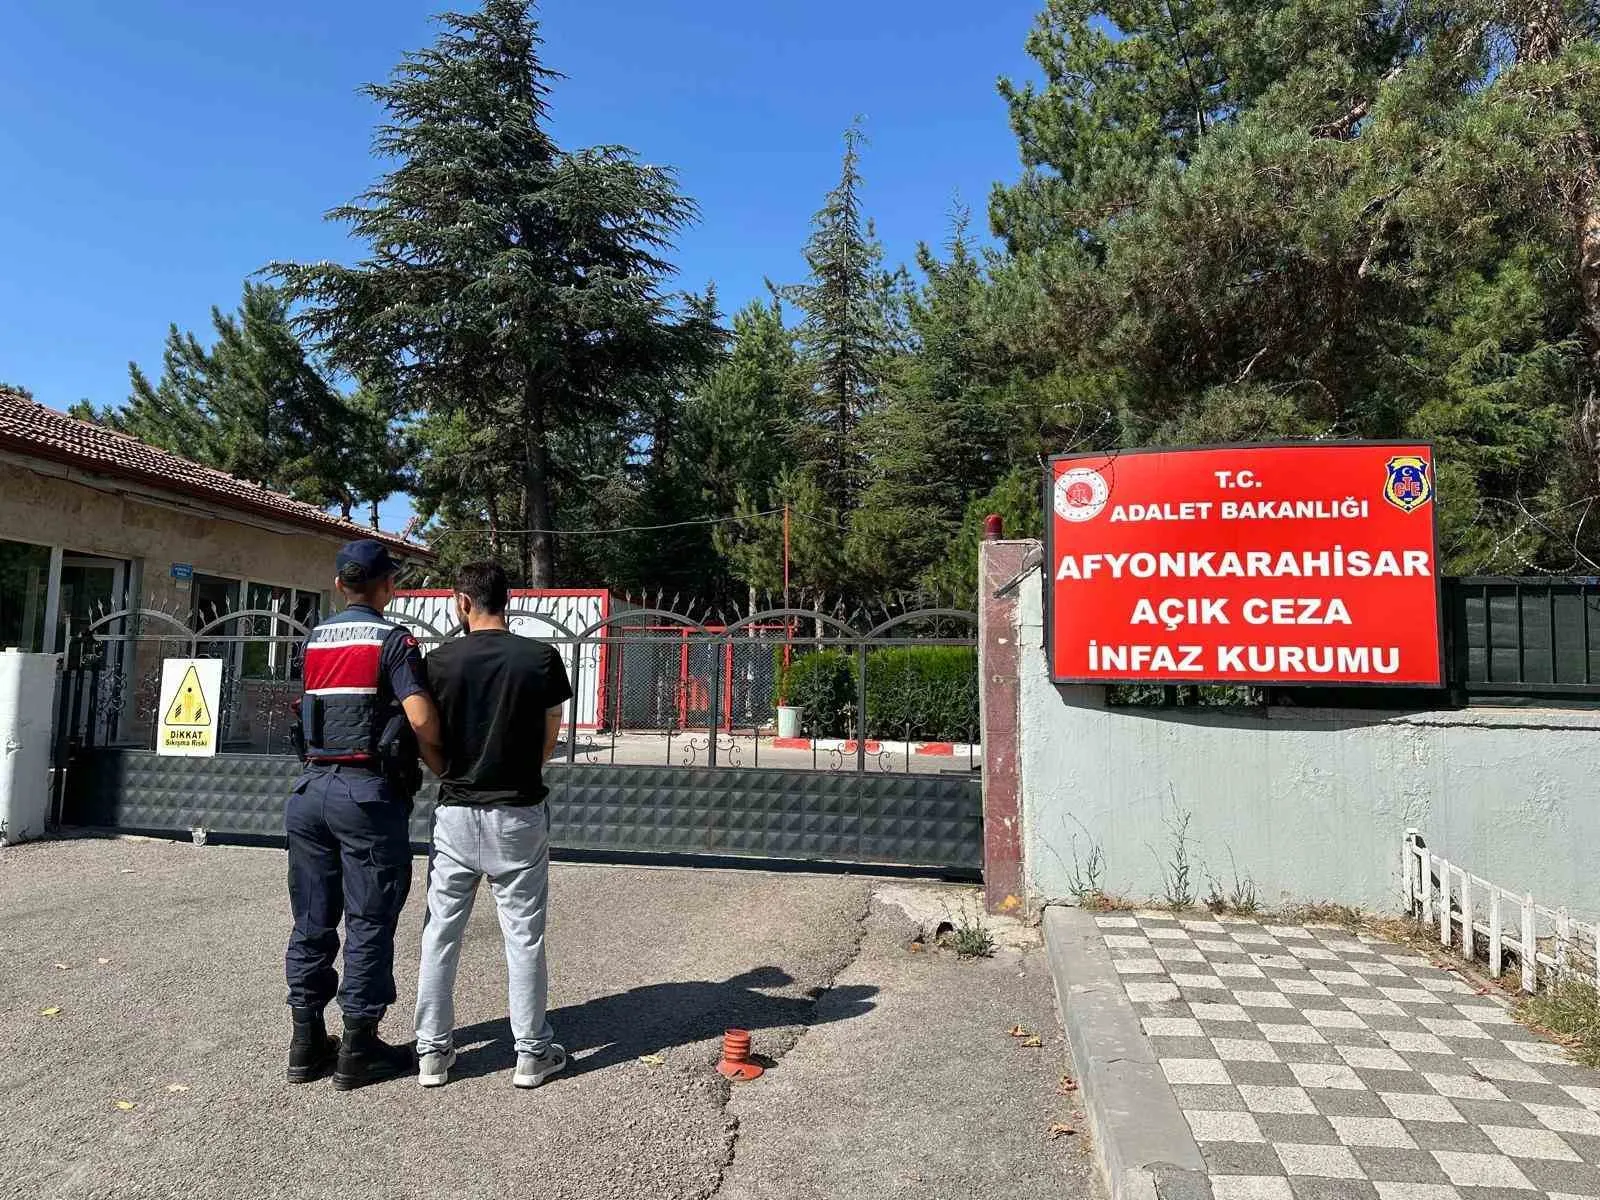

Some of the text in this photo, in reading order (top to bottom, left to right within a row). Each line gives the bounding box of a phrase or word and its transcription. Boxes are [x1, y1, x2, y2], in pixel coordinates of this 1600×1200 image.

[1214, 470, 1262, 488] T.C.
[1109, 496, 1369, 522] ADALET BAKANLIĞI
[1055, 545, 1431, 581] AFYONKARAHİSAR
[1130, 598, 1353, 631] AÇIK CEZA
[1088, 640, 1400, 674] İNFAZ KURUMU
